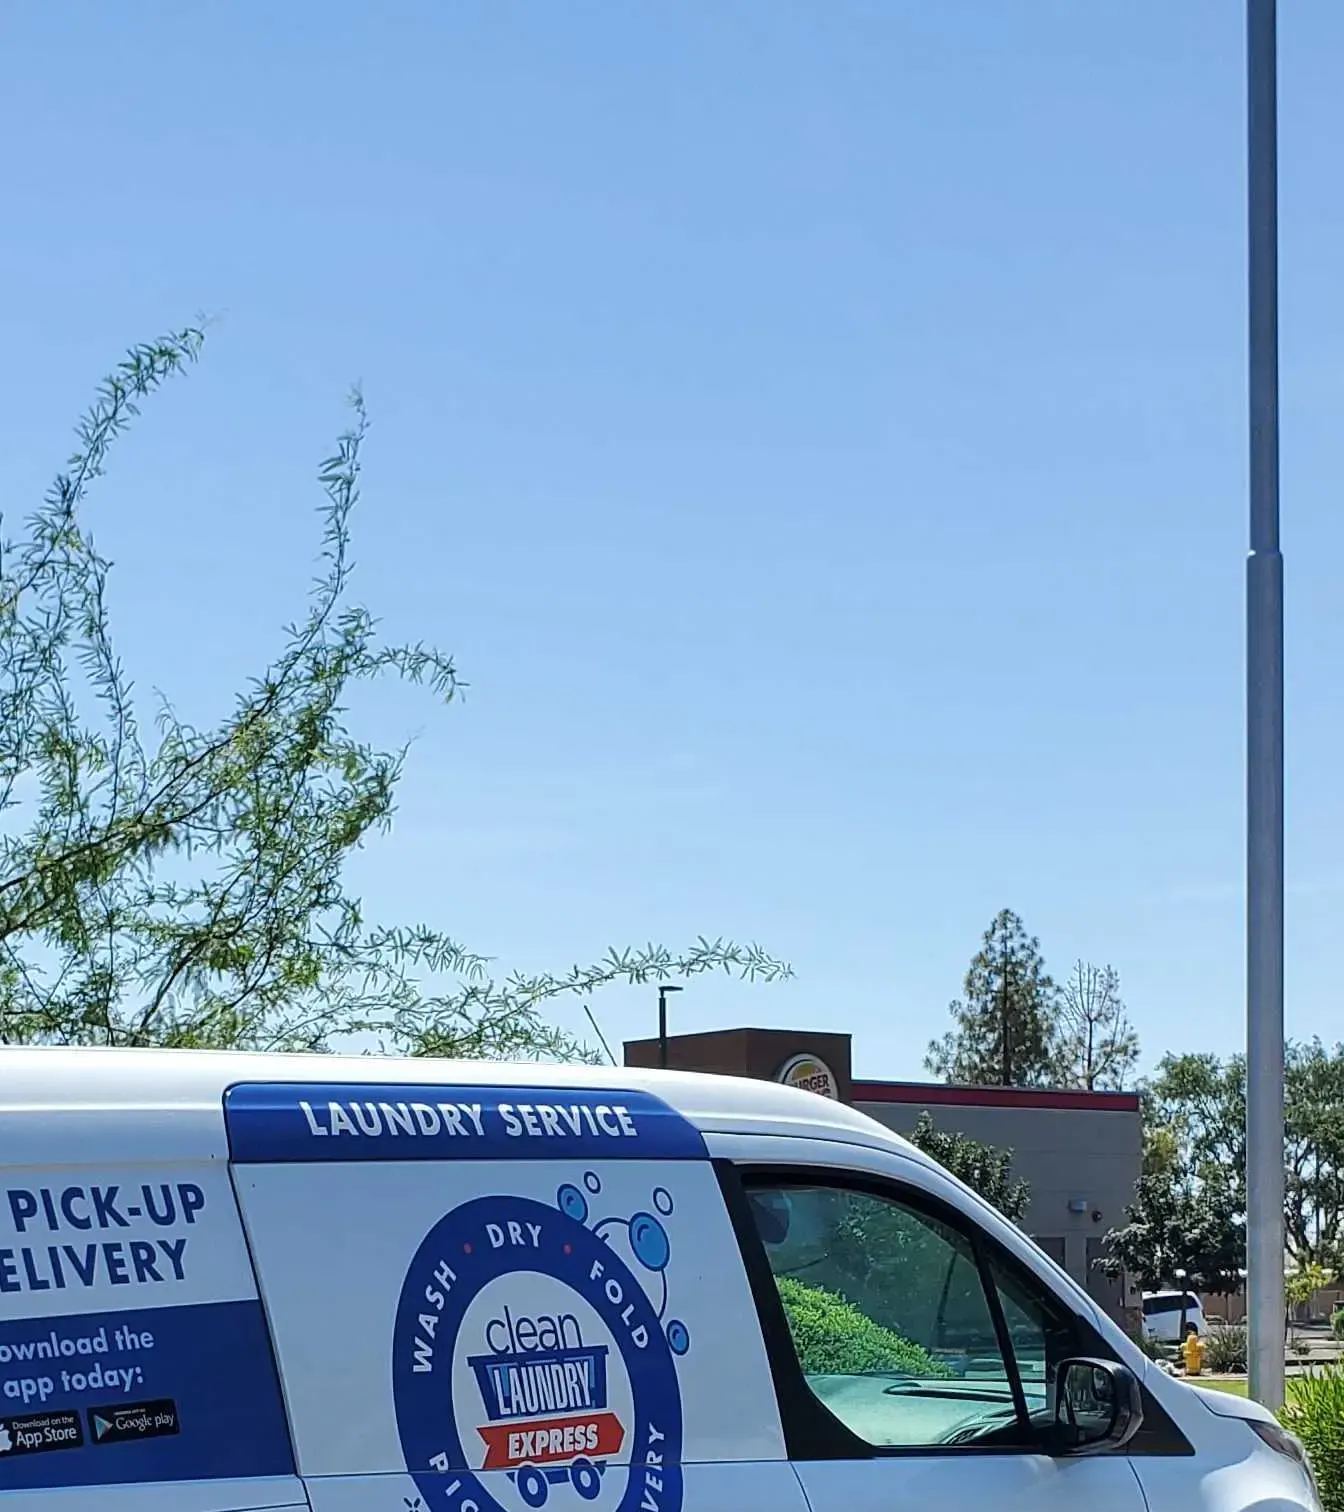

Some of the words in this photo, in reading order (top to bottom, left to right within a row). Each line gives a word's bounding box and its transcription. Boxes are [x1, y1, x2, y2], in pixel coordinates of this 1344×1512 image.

[299, 1101, 485, 1137] LAUNDRY
[498, 1104, 639, 1138] SERVICE
[7, 1183, 206, 1233] PICK-UP
[413, 1260, 457, 1373] WASH
[485, 1221, 542, 1249] DRY
[589, 1260, 649, 1349] FOLD
[115, 1325, 155, 1351] the
[486, 1305, 584, 1355] clean
[4, 1376, 54, 1404] app
[61, 1362, 144, 1393] today:
[493, 1360, 592, 1416] LAUNDRY
[12, 1417, 50, 1430] Download
[51, 1417, 61, 1426] on
[61, 1416, 75, 1425] the
[16, 1431, 44, 1448] App
[45, 1426, 77, 1442] Store
[115, 1413, 152, 1432] Google
[154, 1412, 175, 1429] play
[508, 1423, 599, 1460] EXPRESS
